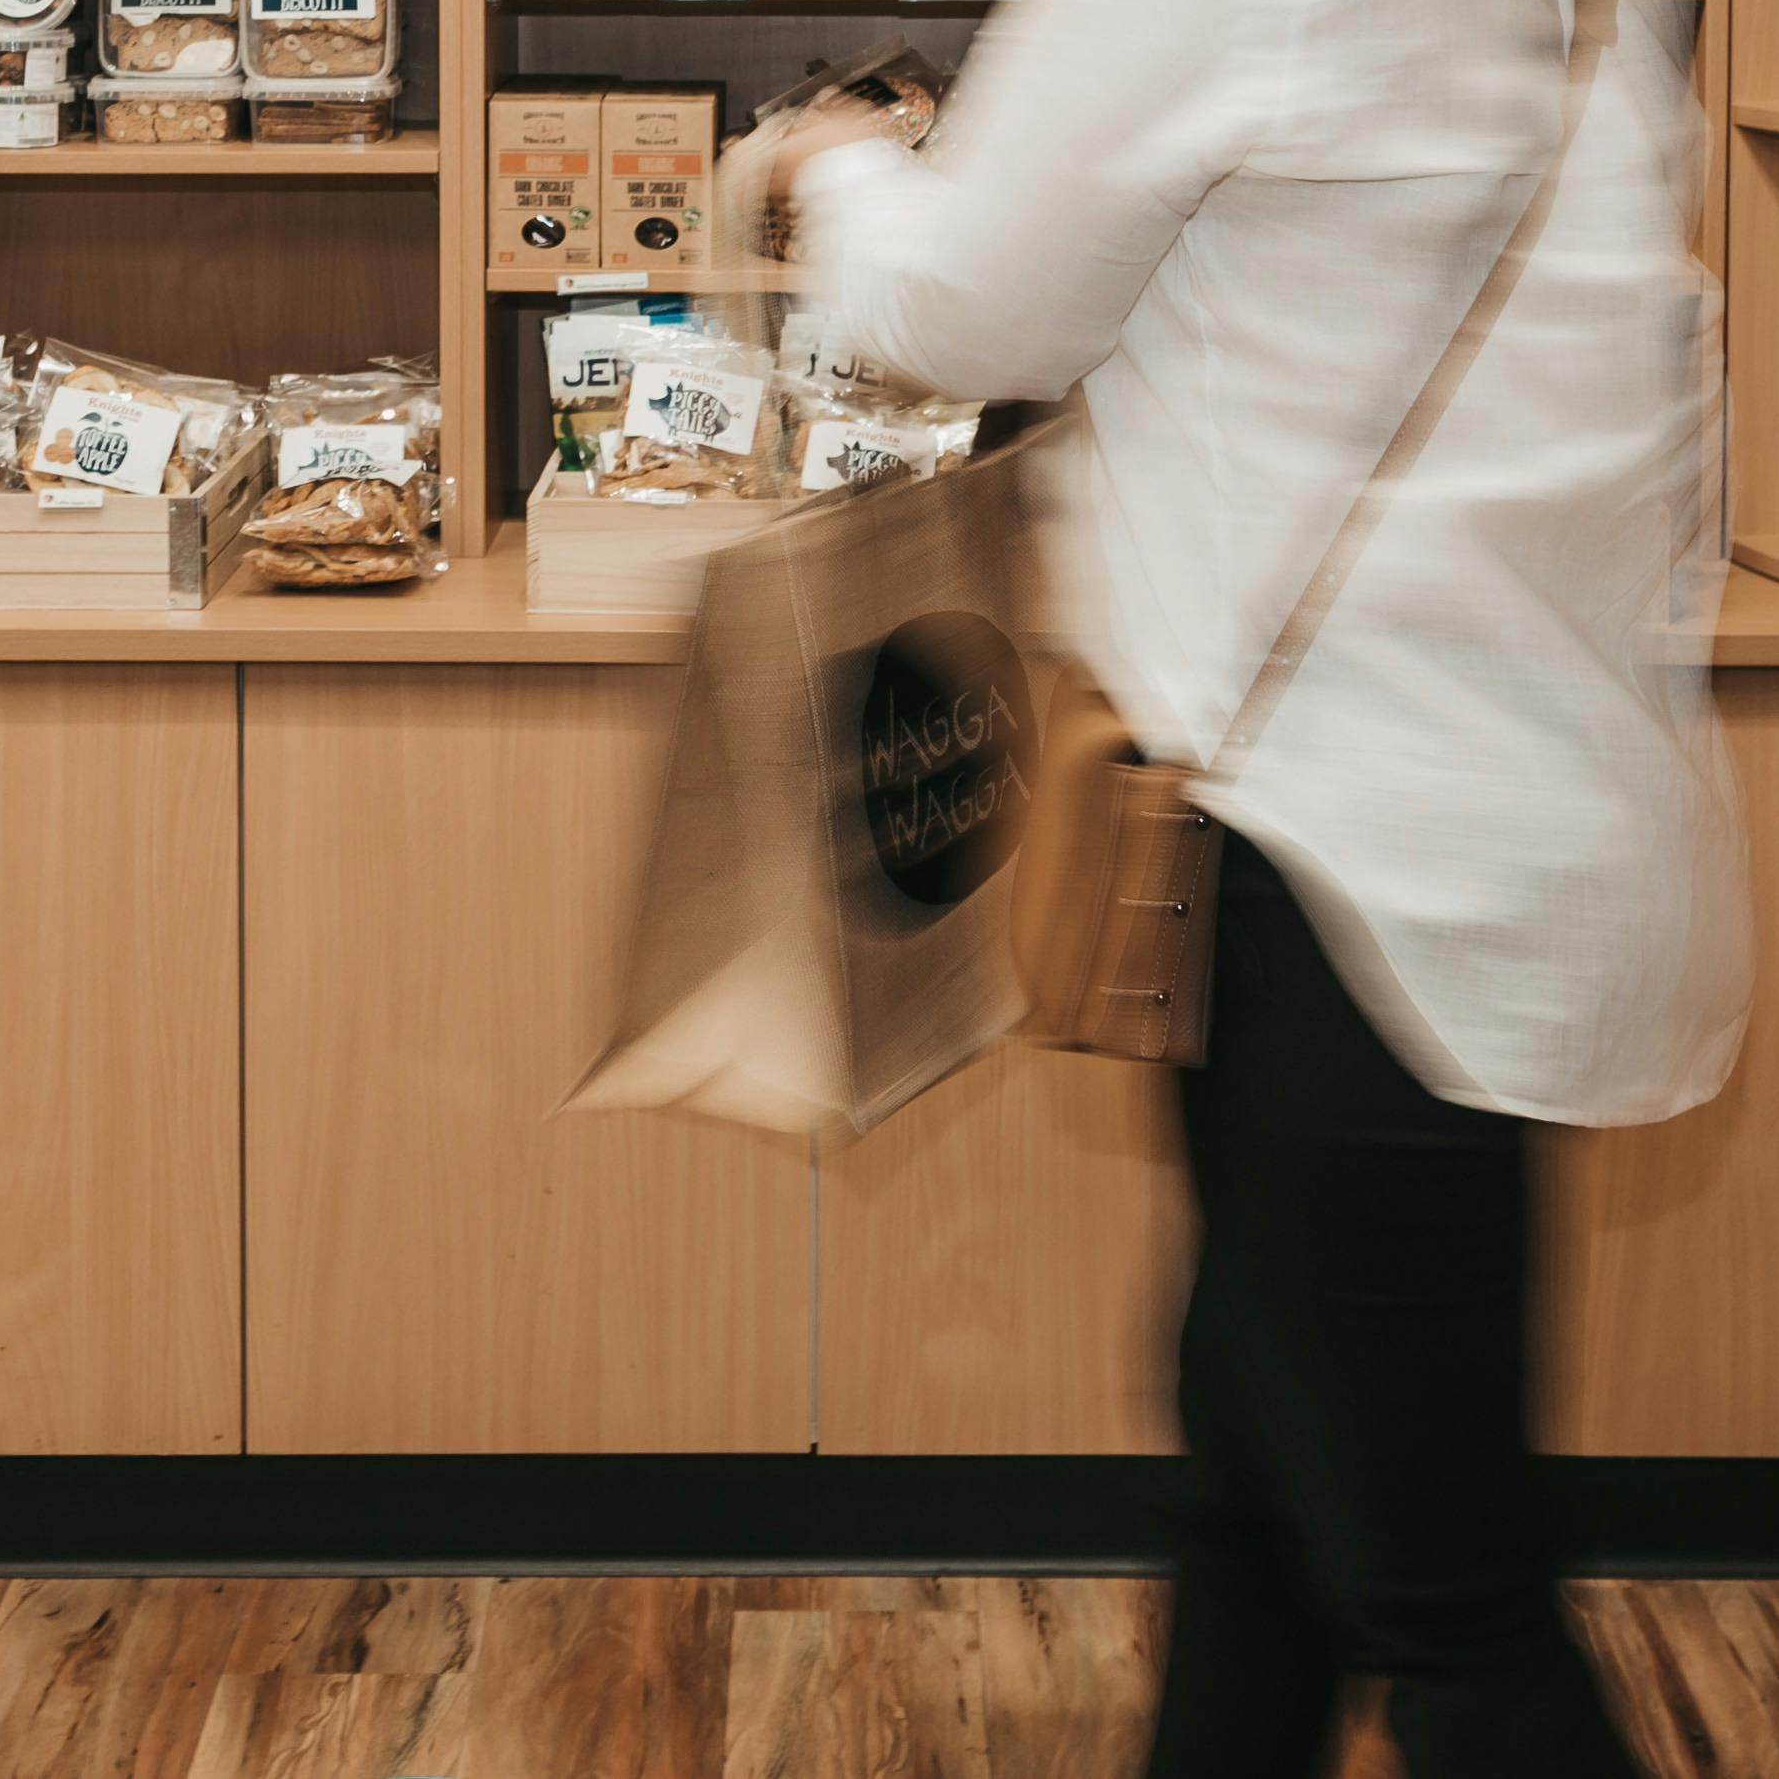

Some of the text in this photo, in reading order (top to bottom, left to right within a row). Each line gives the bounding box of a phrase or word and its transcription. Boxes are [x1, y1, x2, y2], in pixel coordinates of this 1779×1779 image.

[667, 408, 718, 436] TAILS
[77, 429, 128, 454] TOFFEE
[77, 448, 121, 472] APPLE
[865, 684, 1020, 788] WAGGA
[884, 749, 1031, 859] WAGGA
